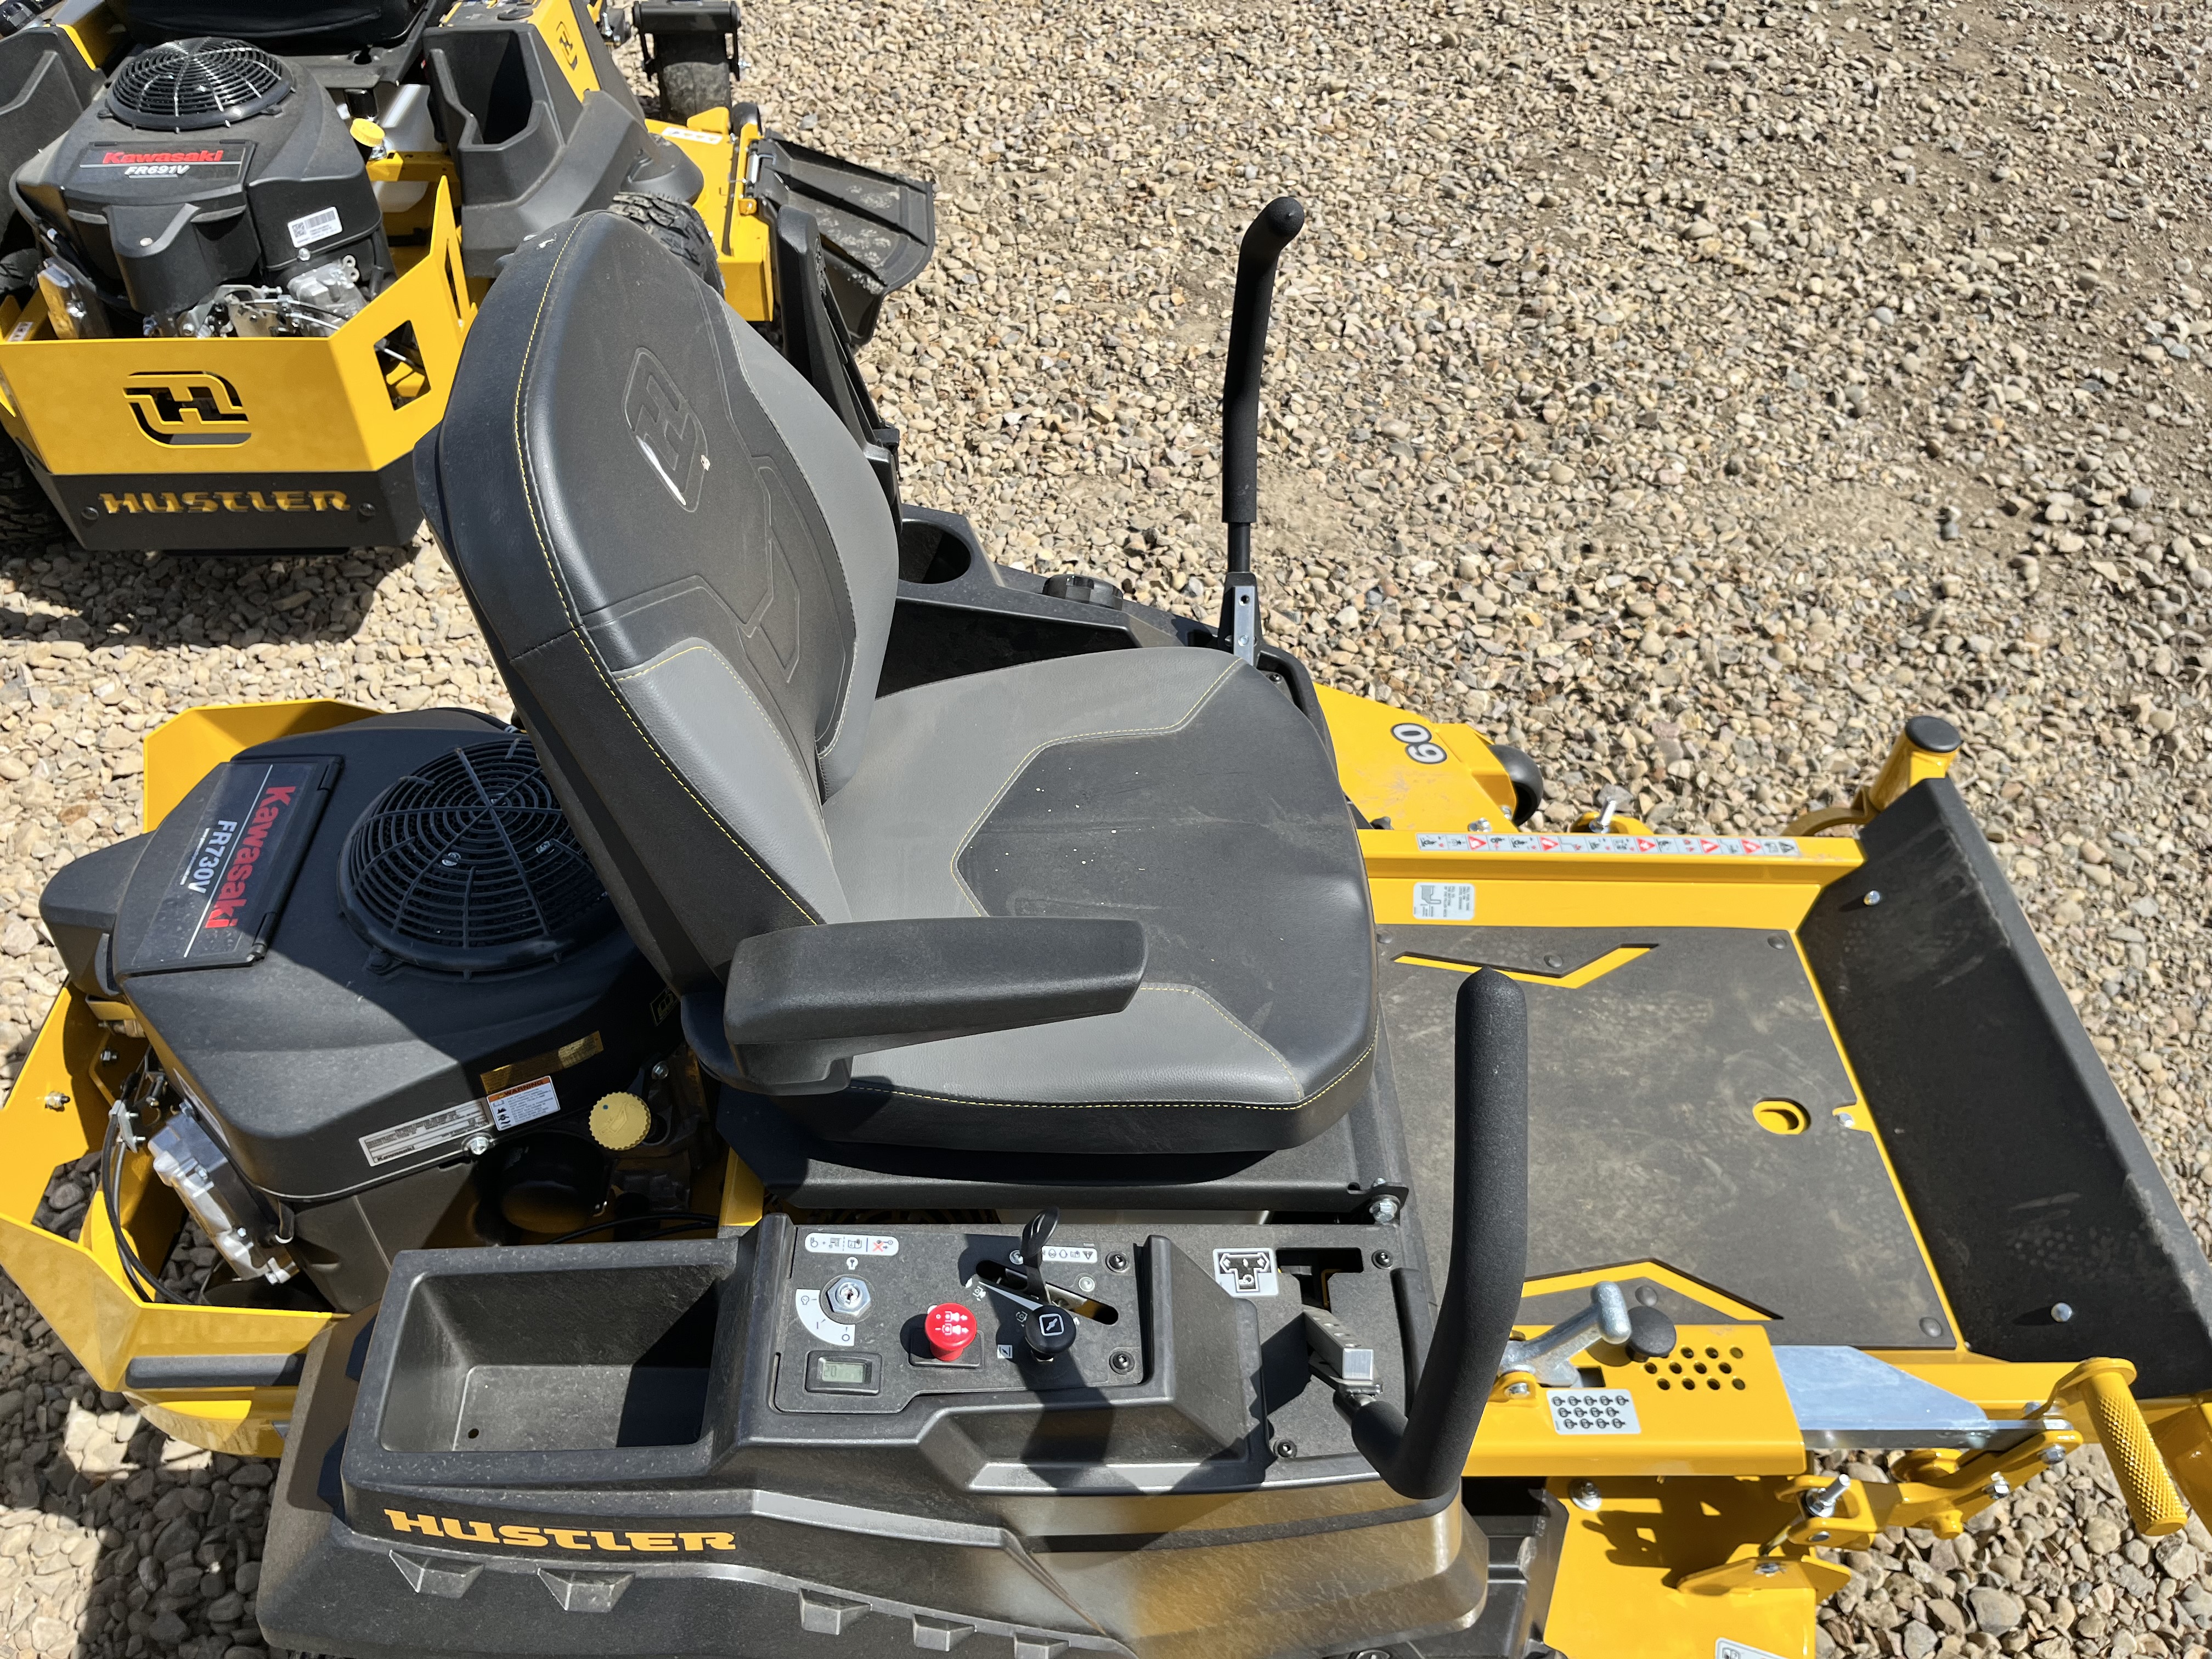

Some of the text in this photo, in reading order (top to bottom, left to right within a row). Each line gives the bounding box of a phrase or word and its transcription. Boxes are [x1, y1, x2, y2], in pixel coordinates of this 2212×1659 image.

[103, 150, 223, 163] Kawasaki
[125, 165, 190, 176] FR691V
[99, 490, 350, 515] HUSTLER
[1391, 723, 1447, 764] 60
[188, 820, 237, 894] FR730V
[205, 786, 296, 928] Kawasaki
[504, 1080, 544, 1097] WARNING
[384, 1509, 736, 1551] HUSTLER
